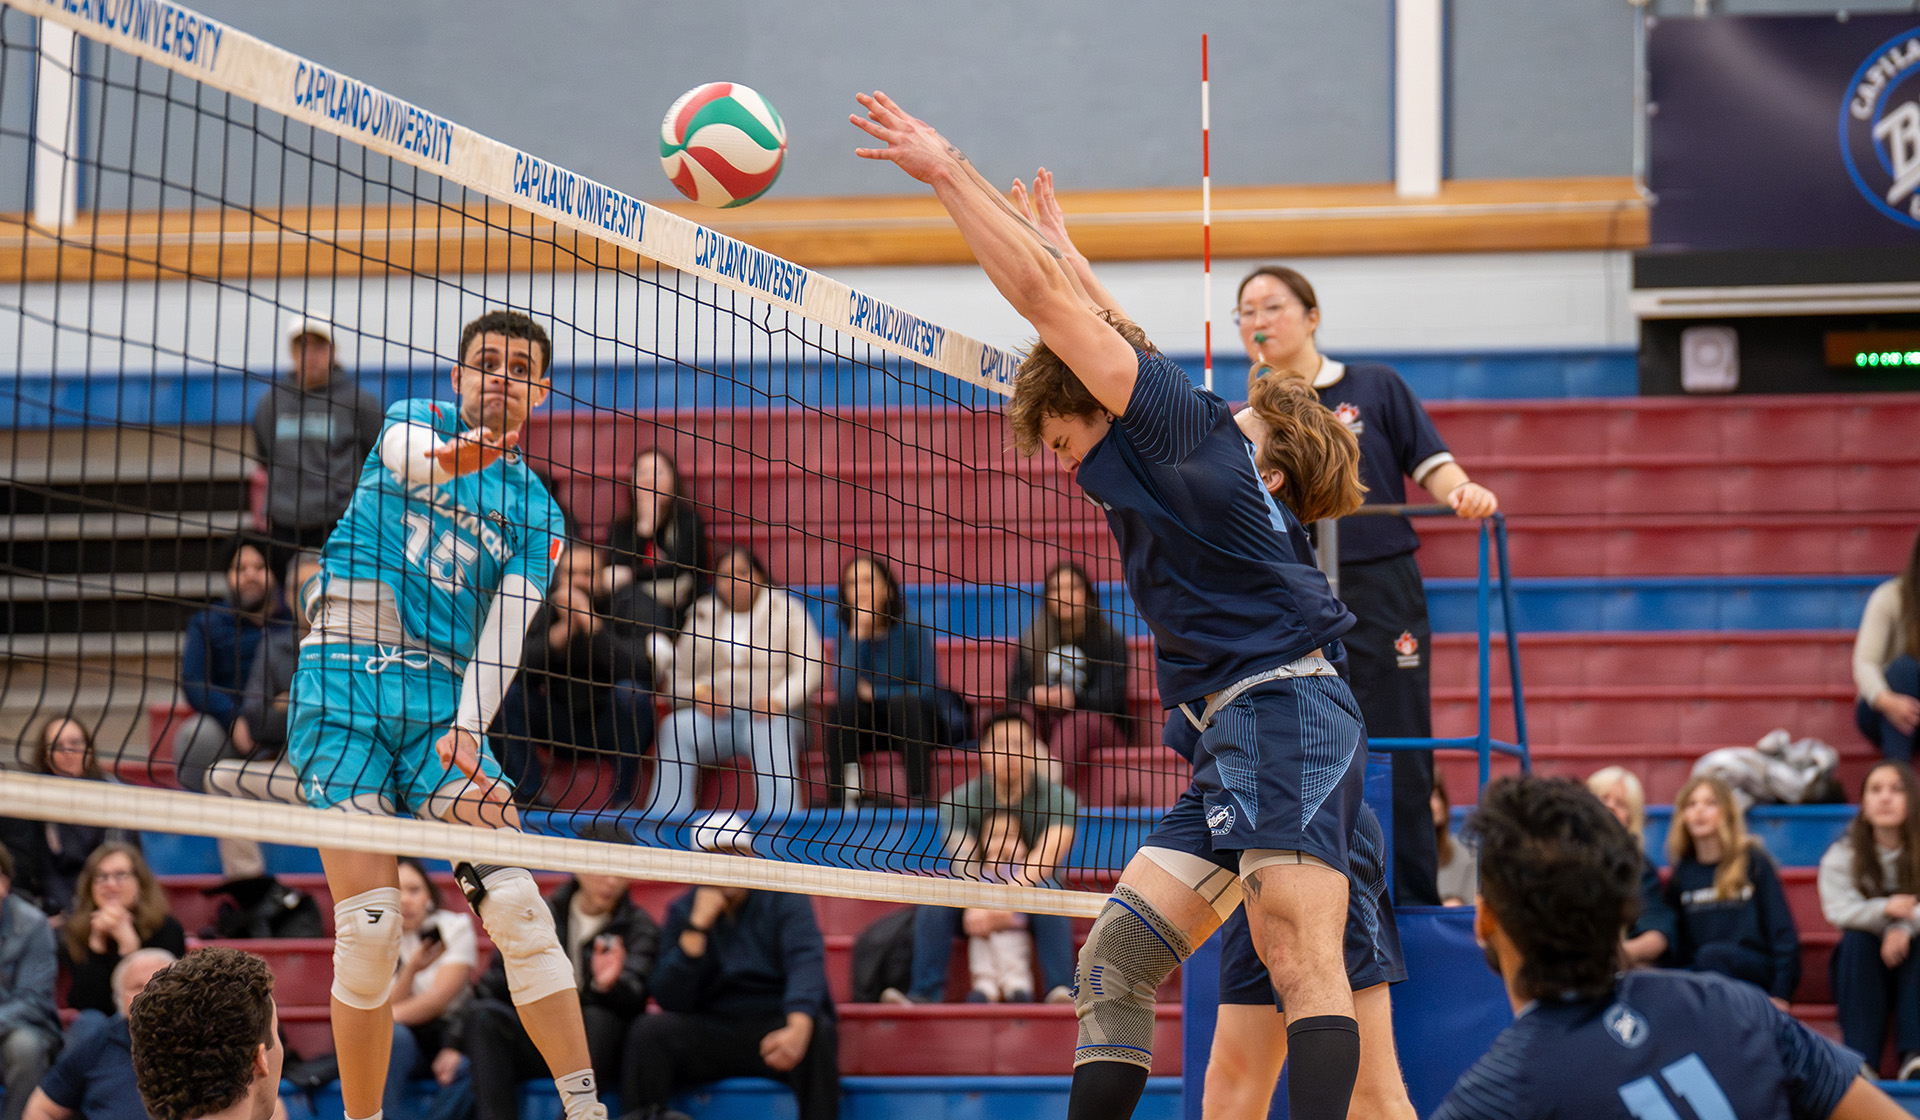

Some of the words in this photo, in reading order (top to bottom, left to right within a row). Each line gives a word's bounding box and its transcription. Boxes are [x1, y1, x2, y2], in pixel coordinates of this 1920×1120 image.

[294, 60, 372, 131] CAPILANO
[371, 92, 453, 165] UNIVERSITY
[514, 152, 575, 215] CAPILANO
[577, 178, 645, 242] UNIVERSITY
[695, 226, 747, 283] CAPILANO
[748, 248, 807, 306] UNIVERSITY
[849, 289, 894, 341] CAPILANO
[894, 309, 945, 361] UNIVERSITY
[401, 508, 479, 596] 15
